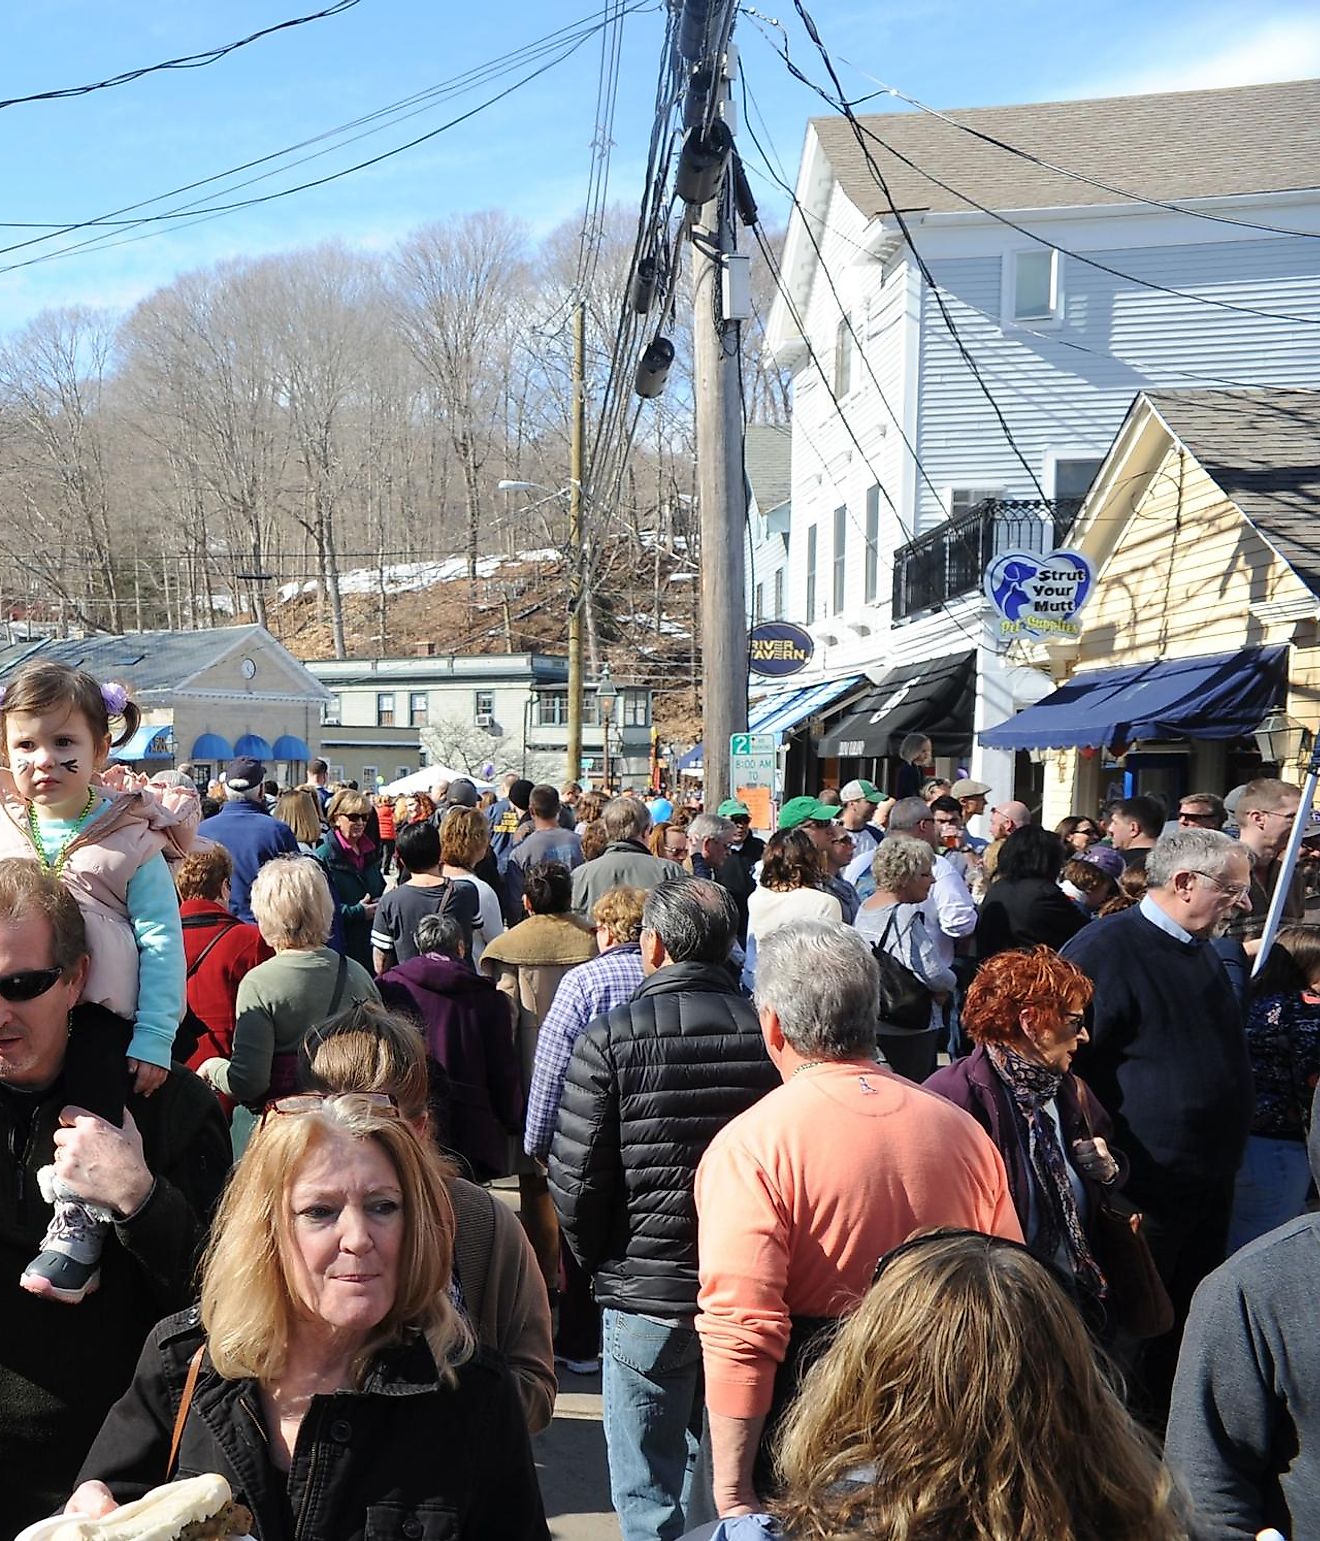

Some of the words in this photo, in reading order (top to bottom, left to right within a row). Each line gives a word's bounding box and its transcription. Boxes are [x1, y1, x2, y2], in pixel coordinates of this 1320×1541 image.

[1038, 570, 1086, 581] Strut
[1032, 585, 1074, 597] Your
[1034, 601, 1074, 612] Mutt
[1001, 620, 1020, 634] Pet
[1027, 615, 1080, 635] Supplies
[749, 640, 794, 650] RIVER
[747, 650, 805, 660] TAVERN
[735, 736, 748, 754] 2
[736, 760, 756, 768] 8:00
[760, 760, 771, 768] AM
[748, 772, 758, 780] TO
